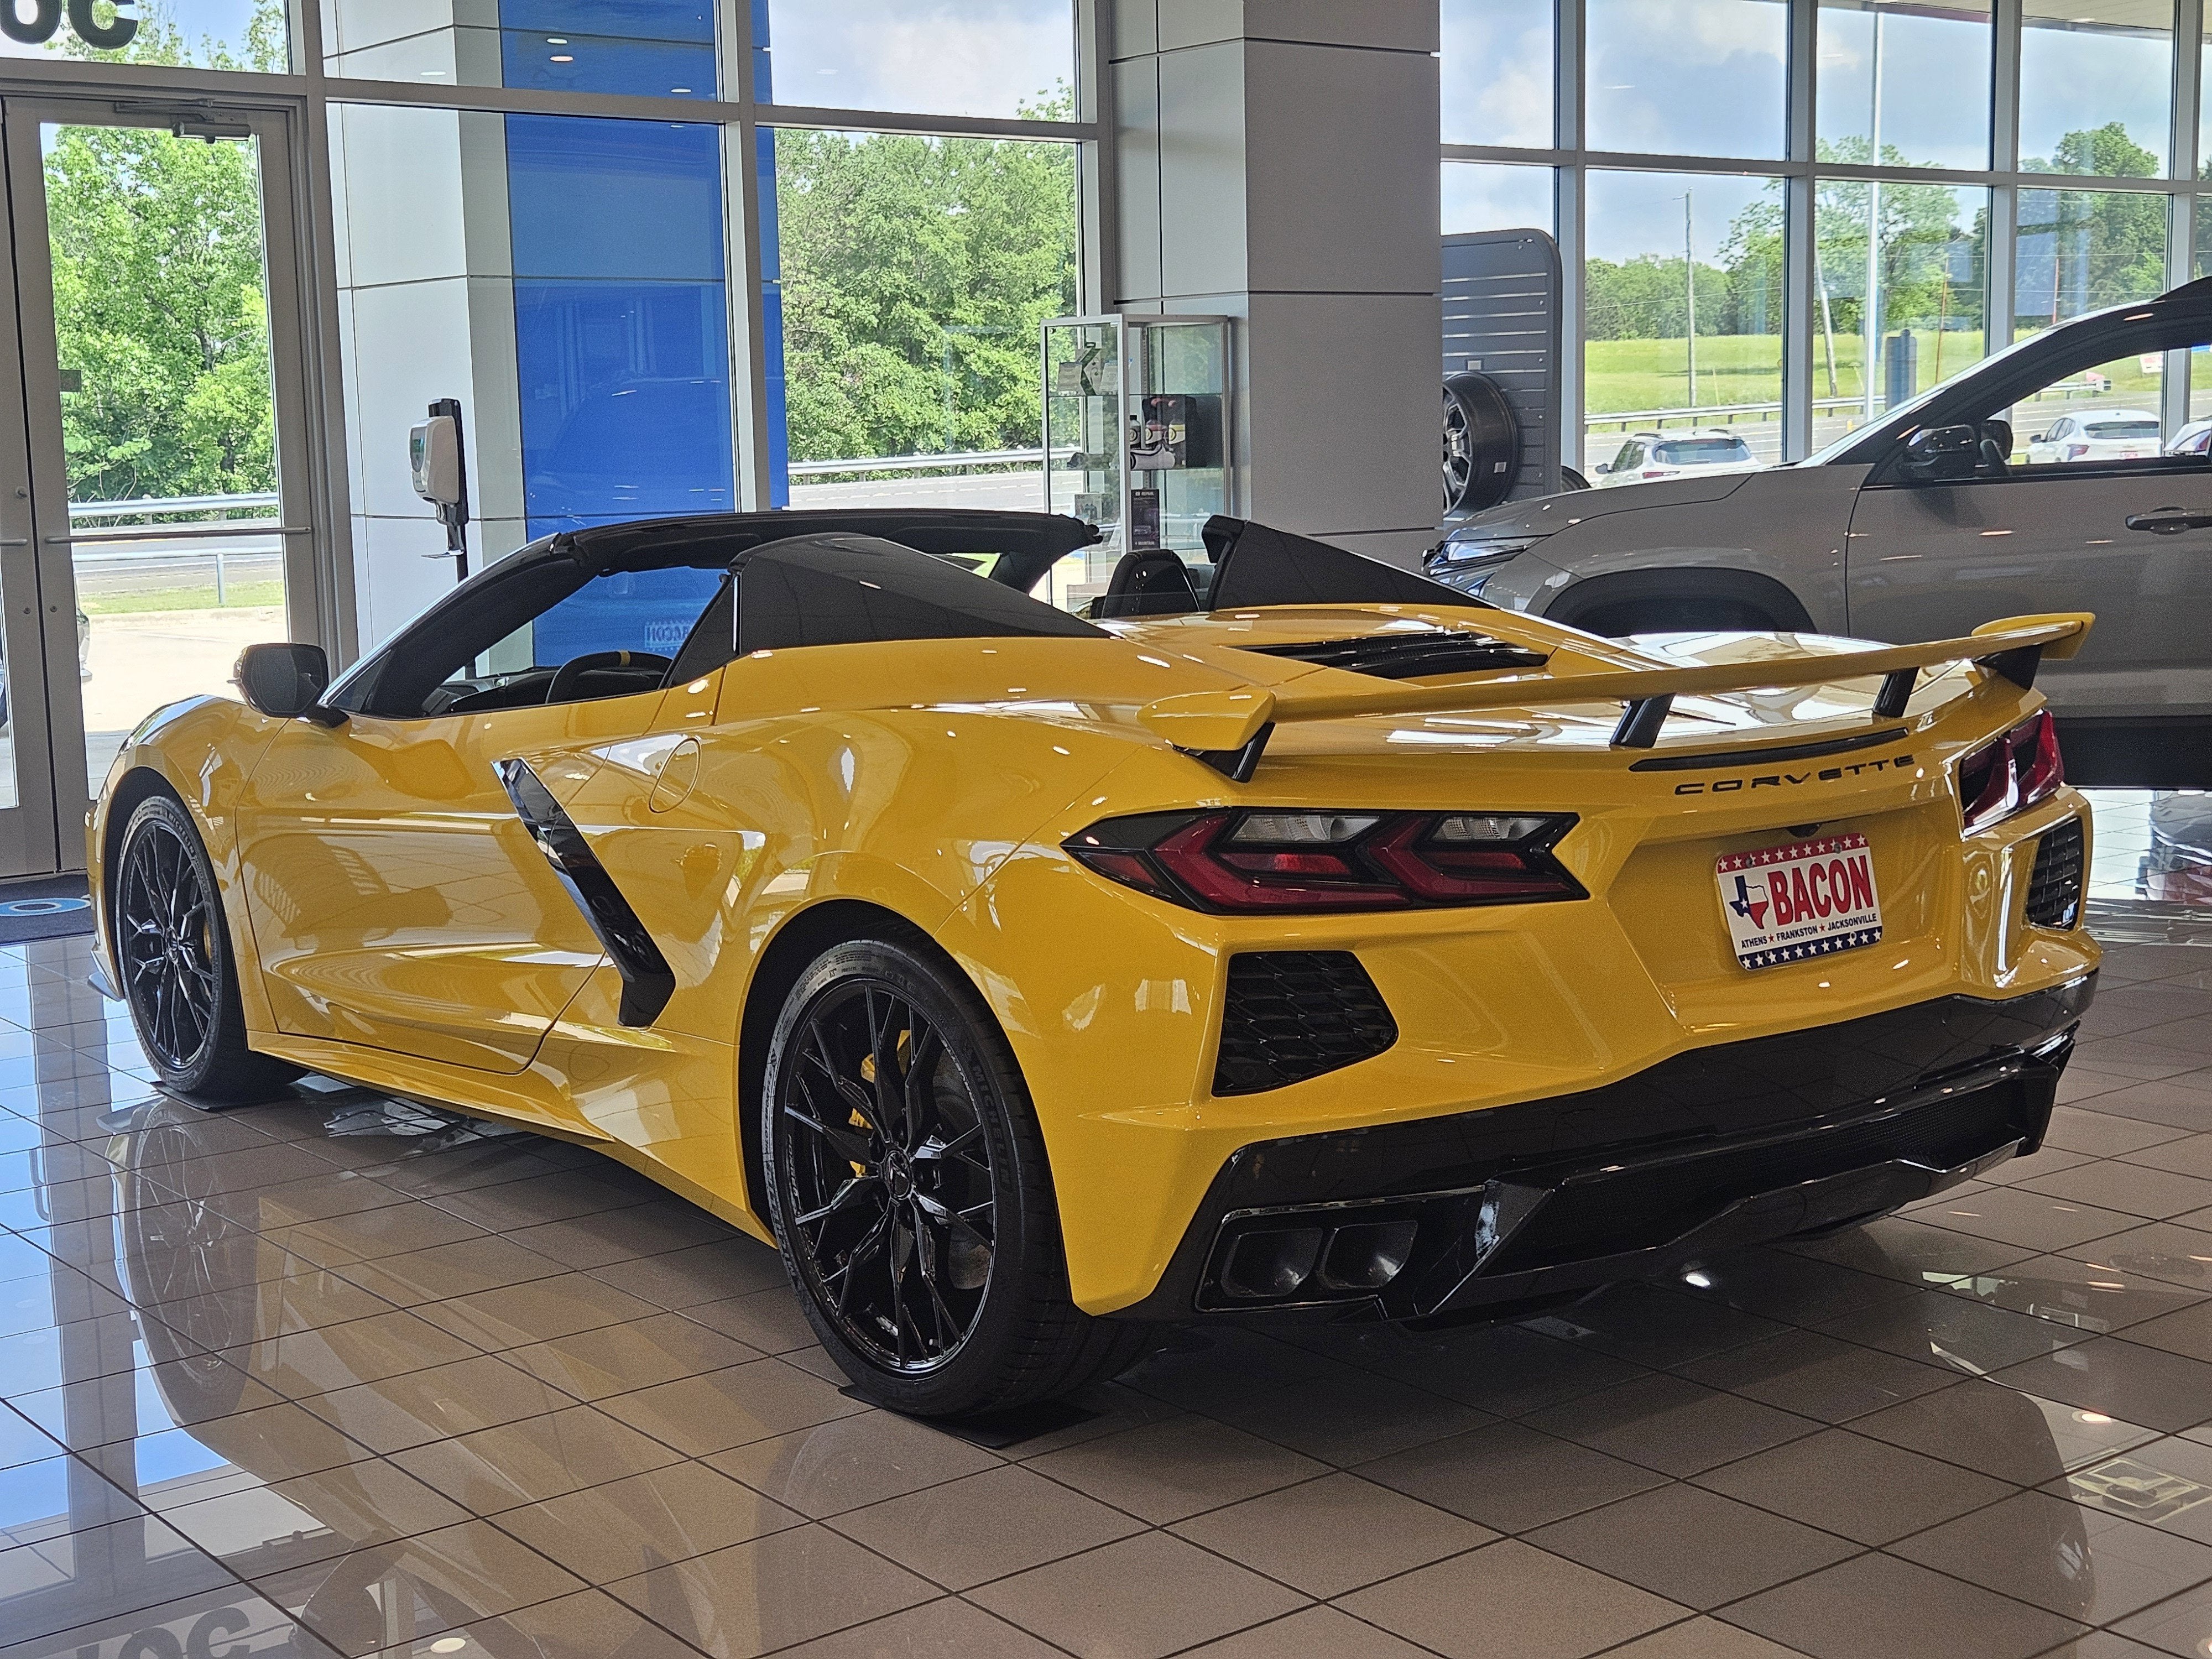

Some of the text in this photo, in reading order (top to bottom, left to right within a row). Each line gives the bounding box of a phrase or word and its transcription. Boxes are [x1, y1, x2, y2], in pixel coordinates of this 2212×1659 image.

[1674, 754, 1914, 795] CORVETTE
[168, 814, 194, 854] MICHELIN
[1767, 855, 1874, 926] BACON
[1741, 913, 1877, 949] ATHENS FRANKSTON JACKSONVILLE
[766, 1161, 796, 1276] MICHELIN
